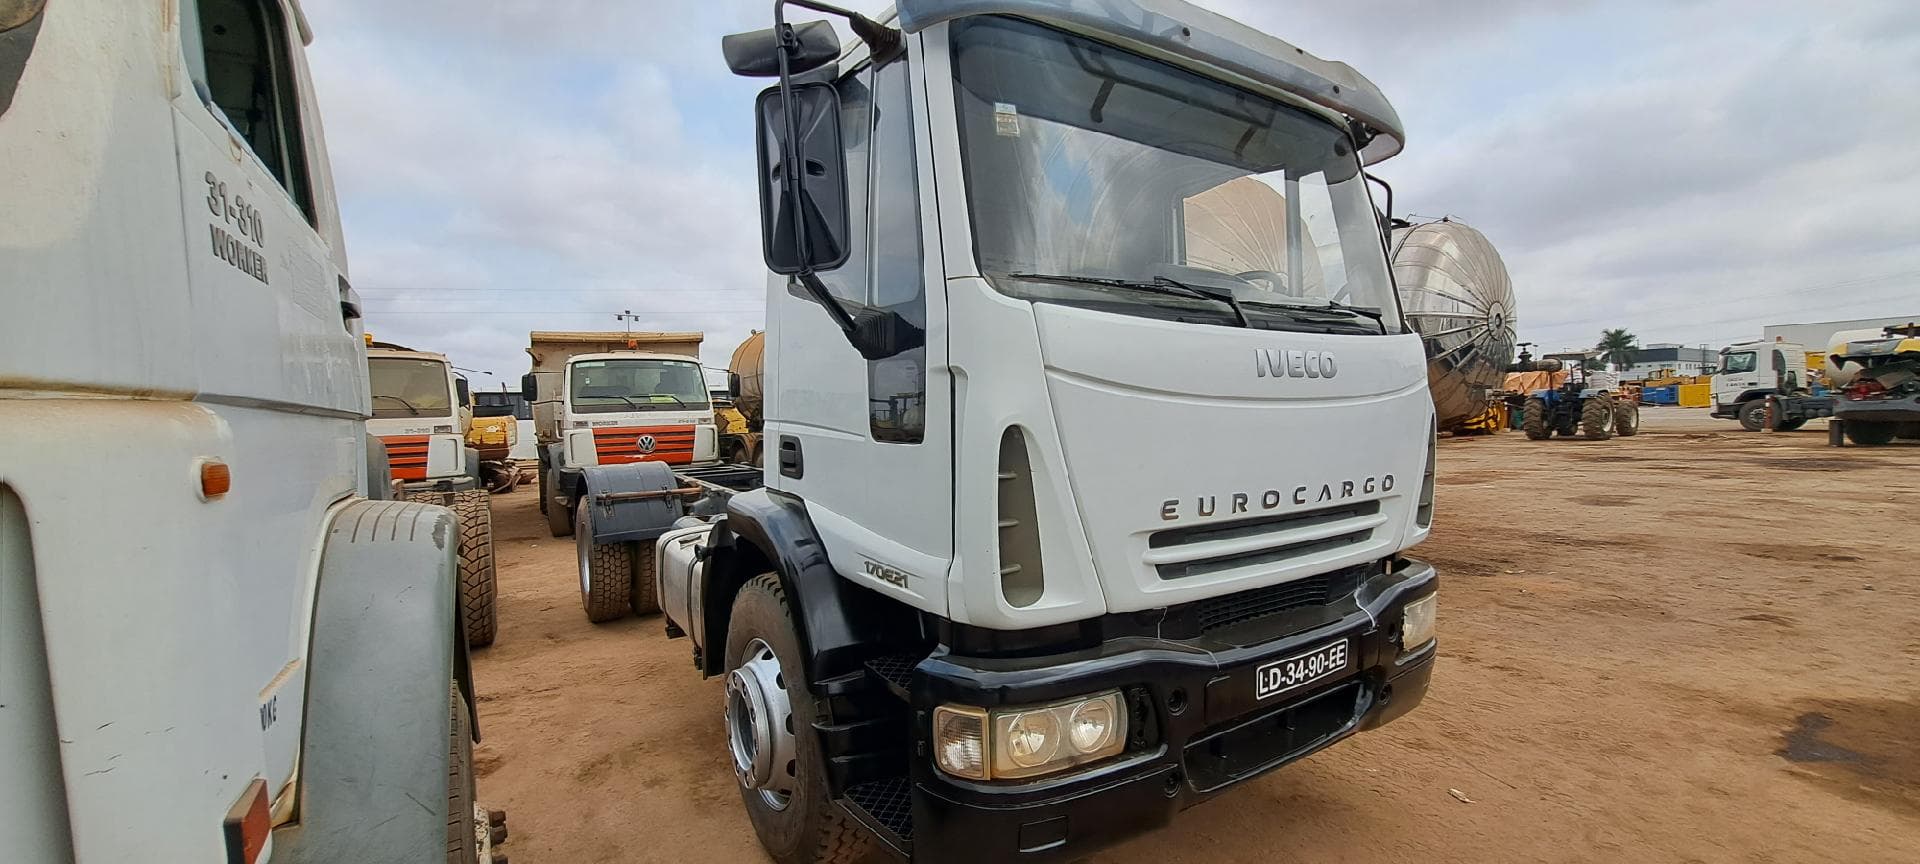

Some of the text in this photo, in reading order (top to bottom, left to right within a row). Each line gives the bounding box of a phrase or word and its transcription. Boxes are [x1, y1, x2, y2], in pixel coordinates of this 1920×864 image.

[204, 171, 264, 249] 31-310
[209, 223, 269, 285] WORKER
[1255, 348, 1339, 379] IVECO
[1161, 475, 1395, 521] EUROCARGO
[864, 560, 909, 589] 170E21
[1259, 644, 1346, 695] LD-34-90-EE
